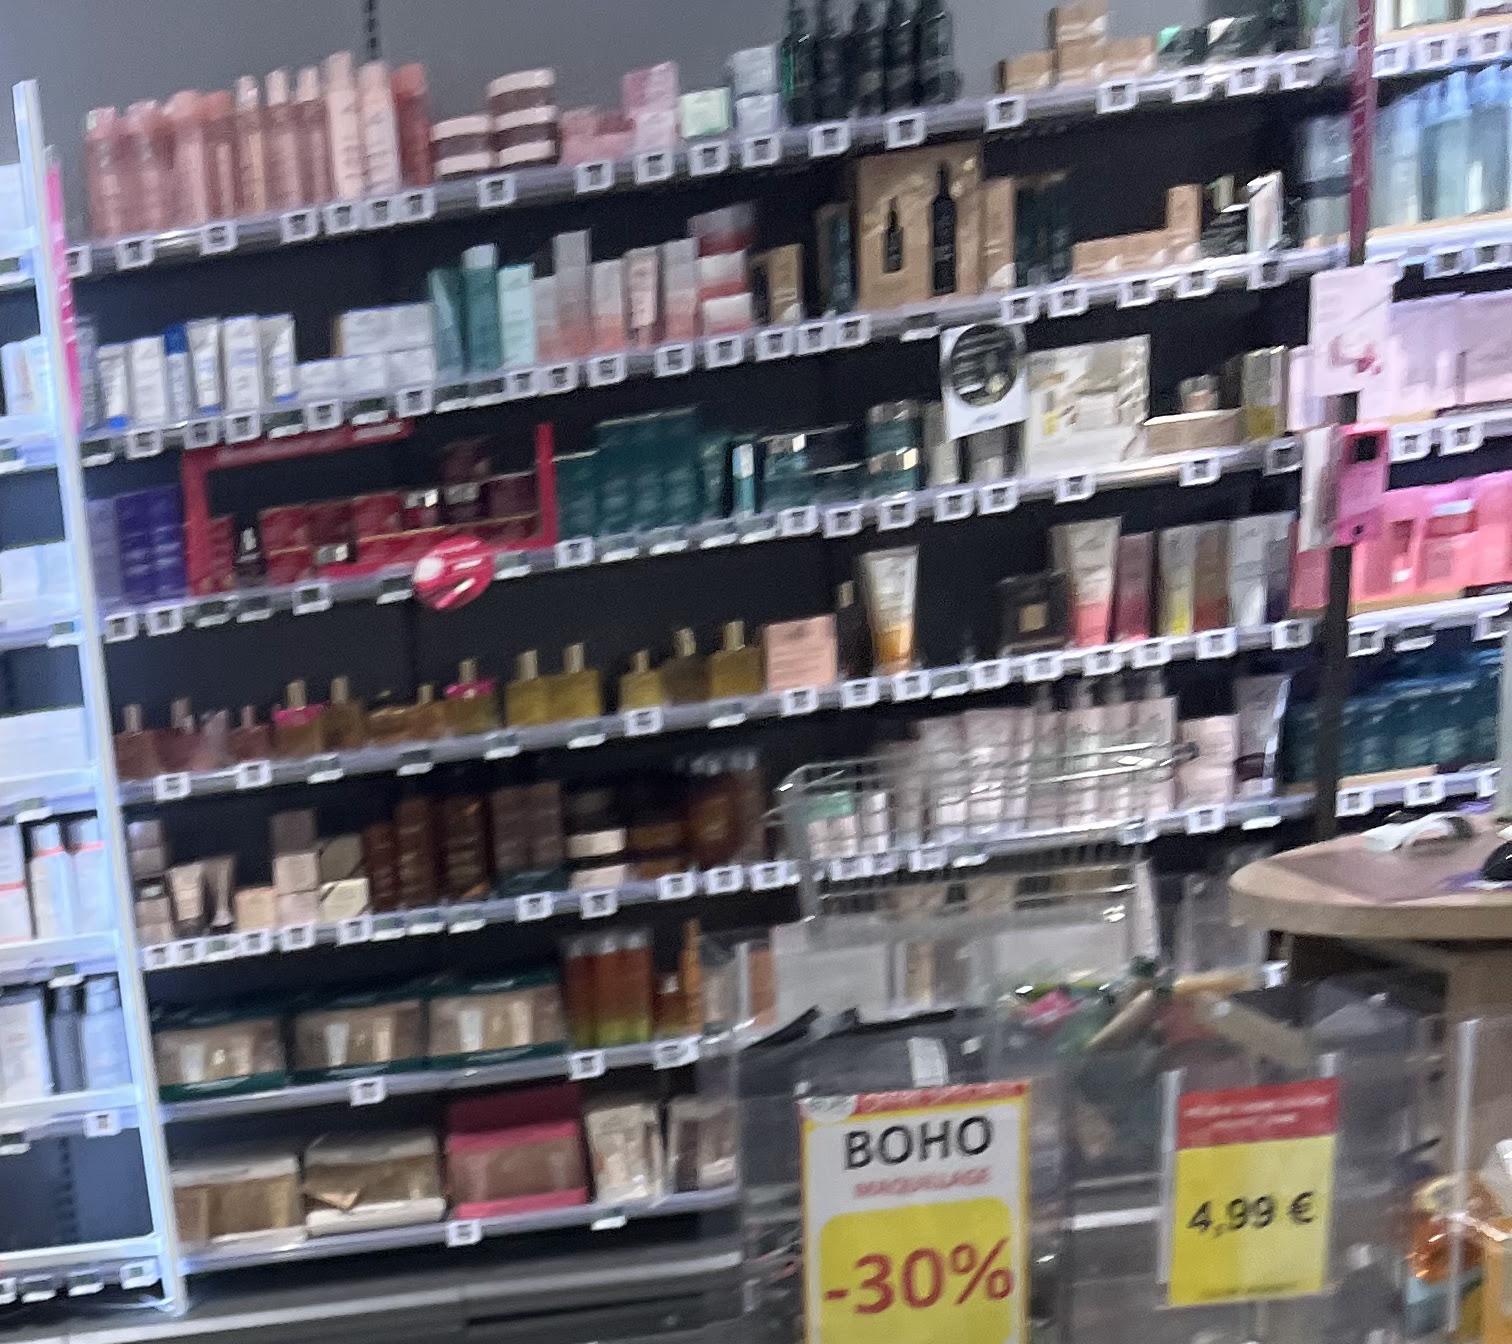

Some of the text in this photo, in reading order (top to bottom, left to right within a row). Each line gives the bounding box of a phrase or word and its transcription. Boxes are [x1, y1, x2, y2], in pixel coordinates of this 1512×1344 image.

[844, 1114, 994, 1170] BOHO
[1187, 1190, 1316, 1238] 4,99 €
[824, 1235, 1015, 1316] -30%
